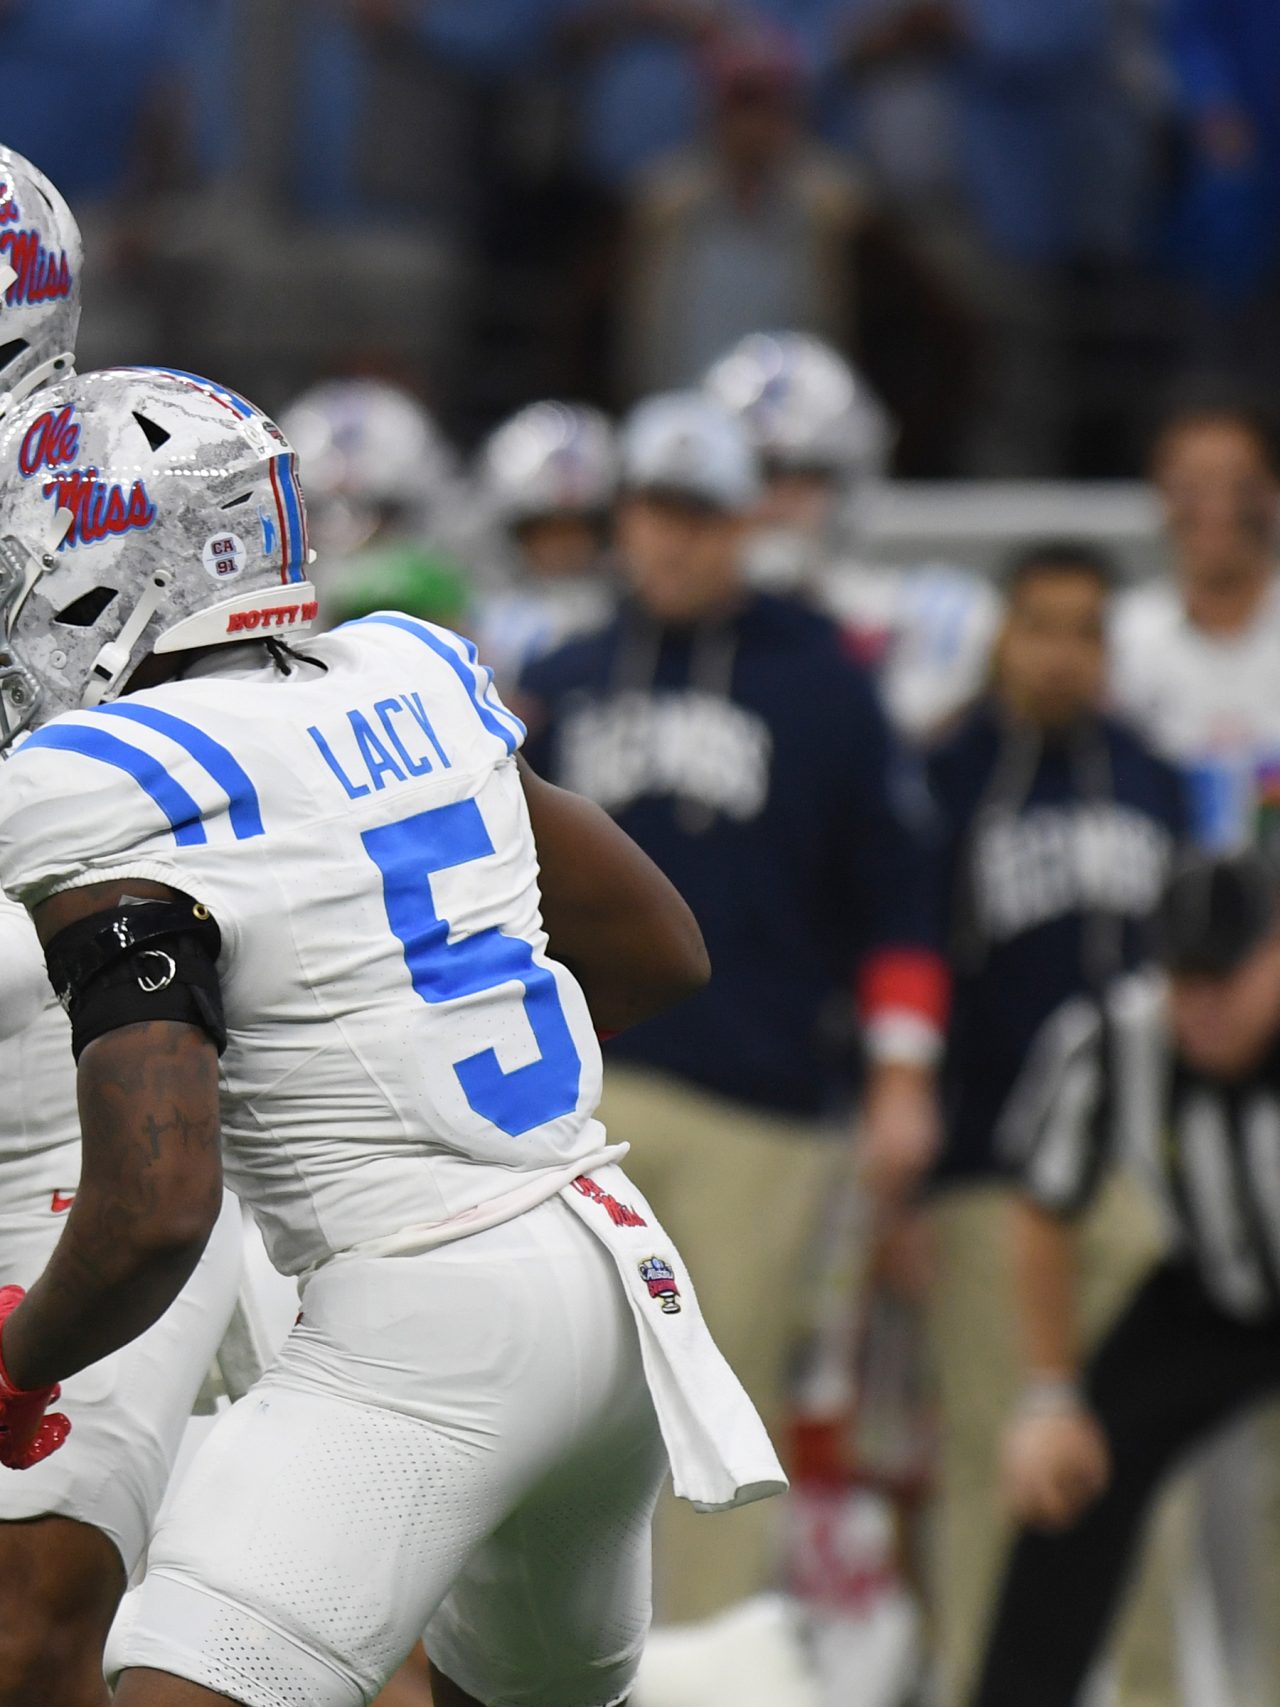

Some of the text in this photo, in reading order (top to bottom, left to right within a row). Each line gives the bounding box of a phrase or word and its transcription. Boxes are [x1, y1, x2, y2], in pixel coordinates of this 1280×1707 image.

[18, 402, 81, 478] Ole
[42, 466, 158, 552] Miss
[216, 558, 237, 575] 91
[306, 691, 452, 800] LACY
[360, 796, 582, 1138] 5
